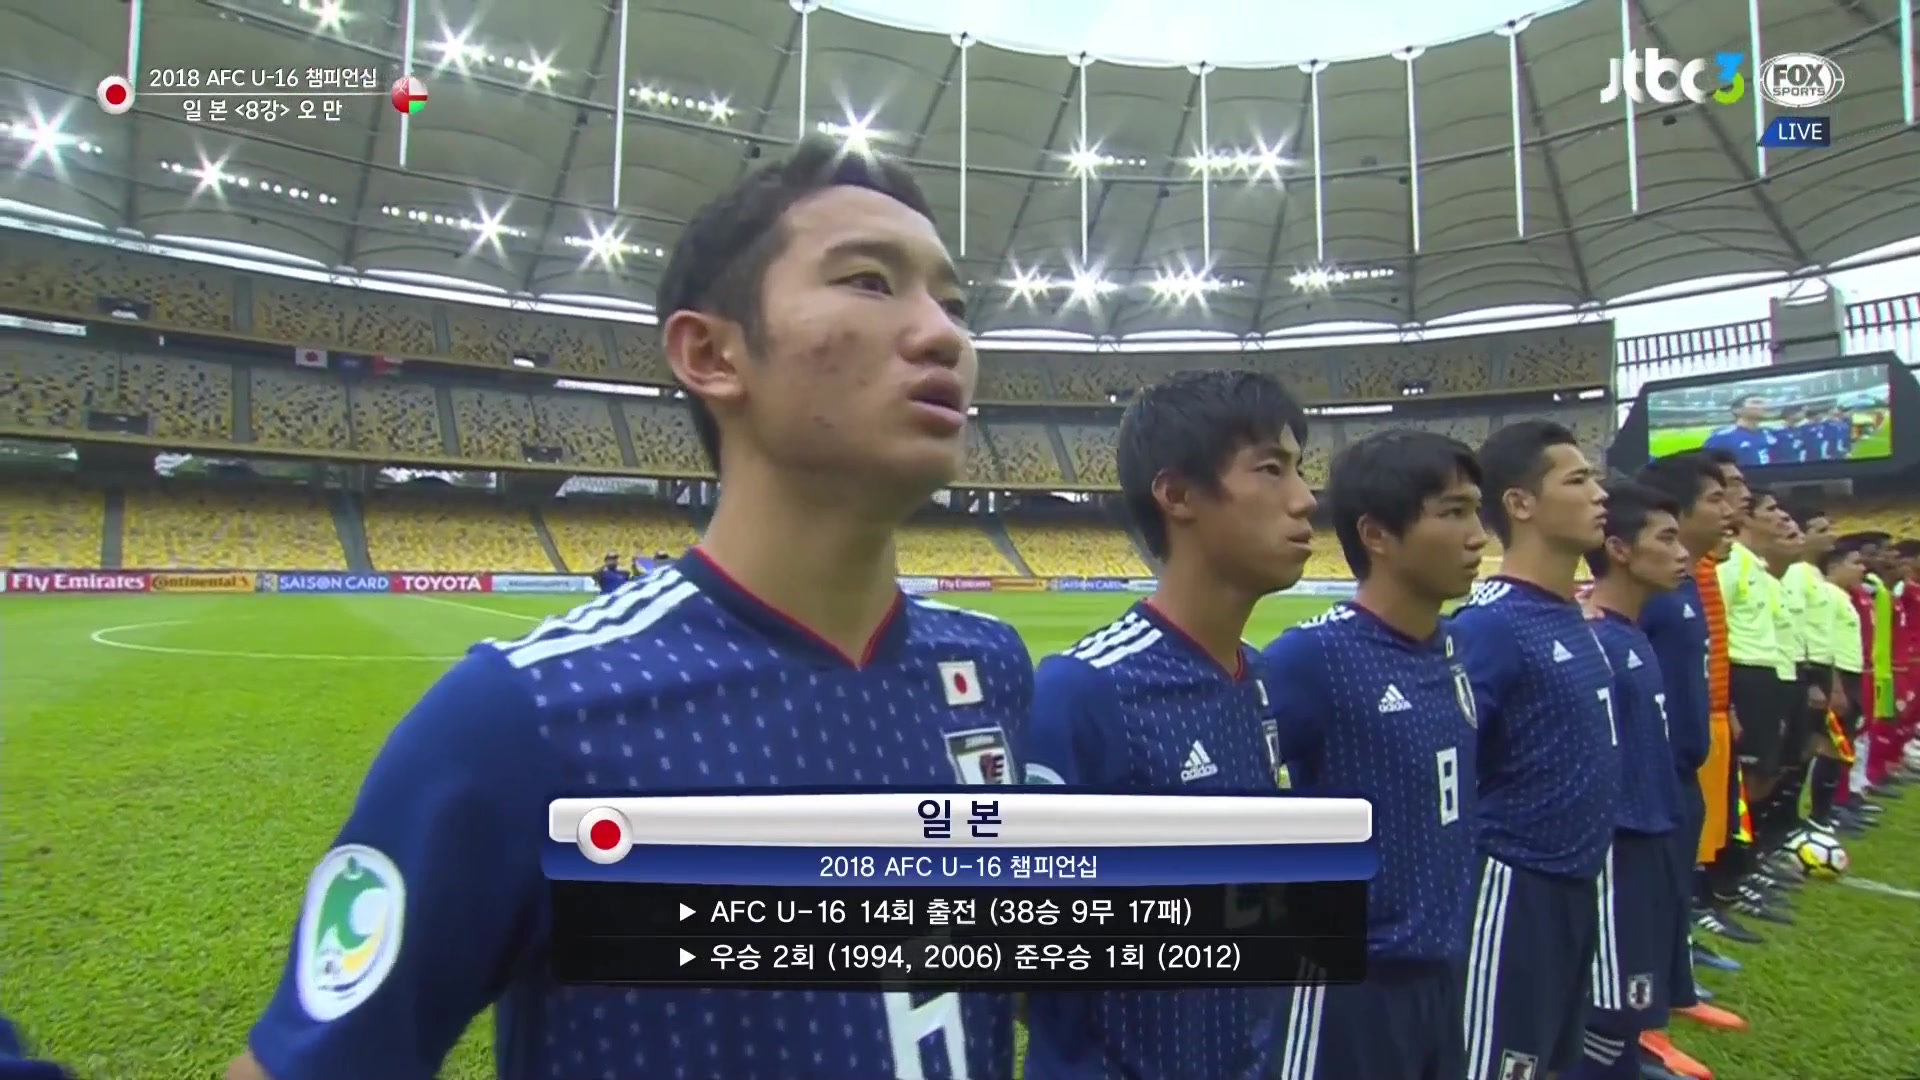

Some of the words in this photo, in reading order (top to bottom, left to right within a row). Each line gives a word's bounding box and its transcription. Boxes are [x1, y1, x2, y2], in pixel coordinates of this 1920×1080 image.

[12, 573, 49, 591] Fly
[54, 573, 144, 589] Emirates
[280, 576, 341, 589] SAISON
[345, 576, 389, 589] CARD
[402, 575, 482, 590] TOYOTA
[1181, 763, 1218, 785] adidas
[1436, 746, 1459, 826] 8
